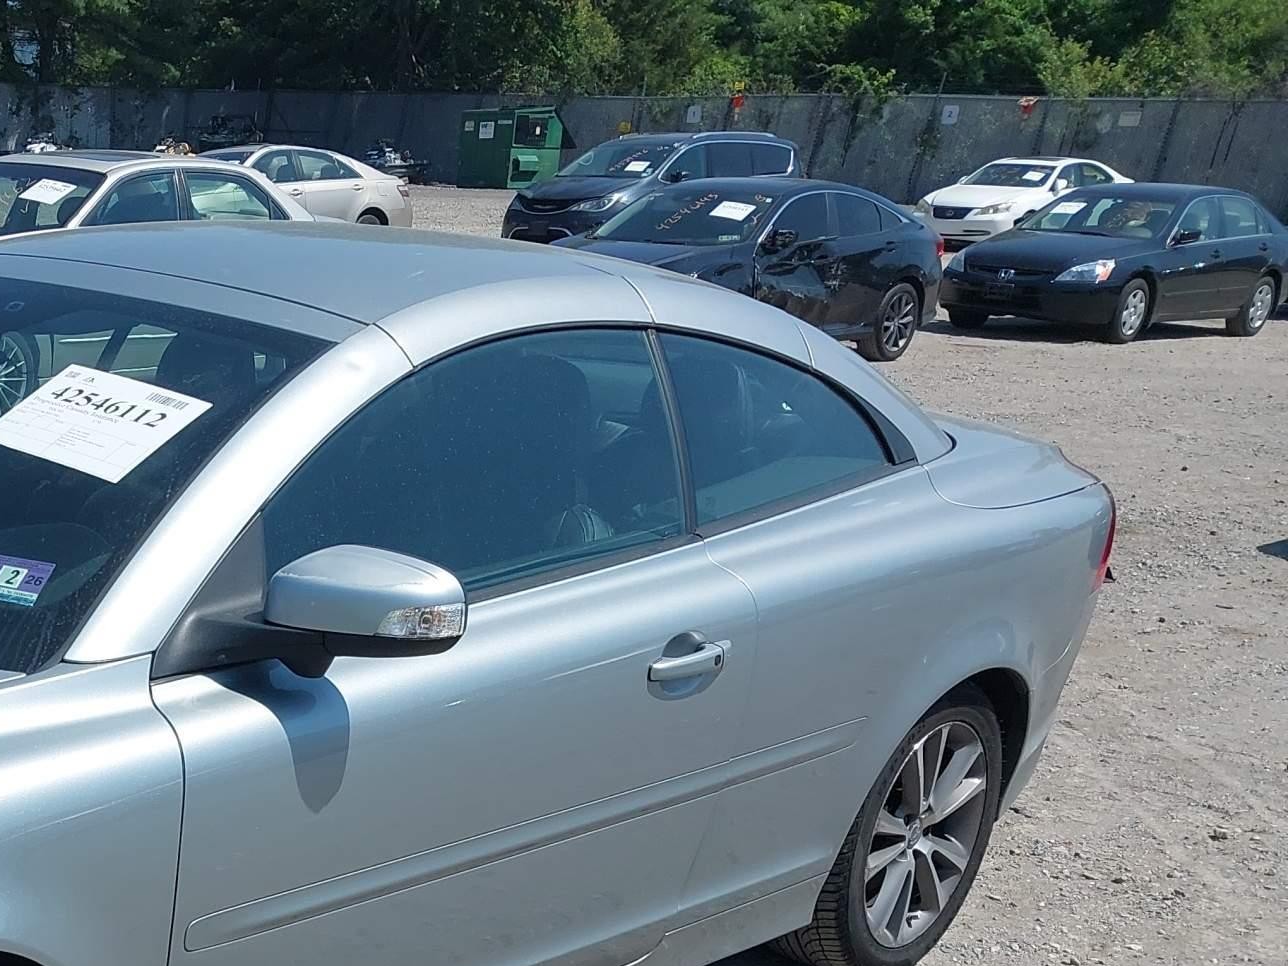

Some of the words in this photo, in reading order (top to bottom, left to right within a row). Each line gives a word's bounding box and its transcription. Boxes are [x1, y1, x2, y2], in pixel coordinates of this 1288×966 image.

[51, 386, 168, 428] 42546112
[5, 569, 21, 585] 2
[24, 575, 44, 587] 26
